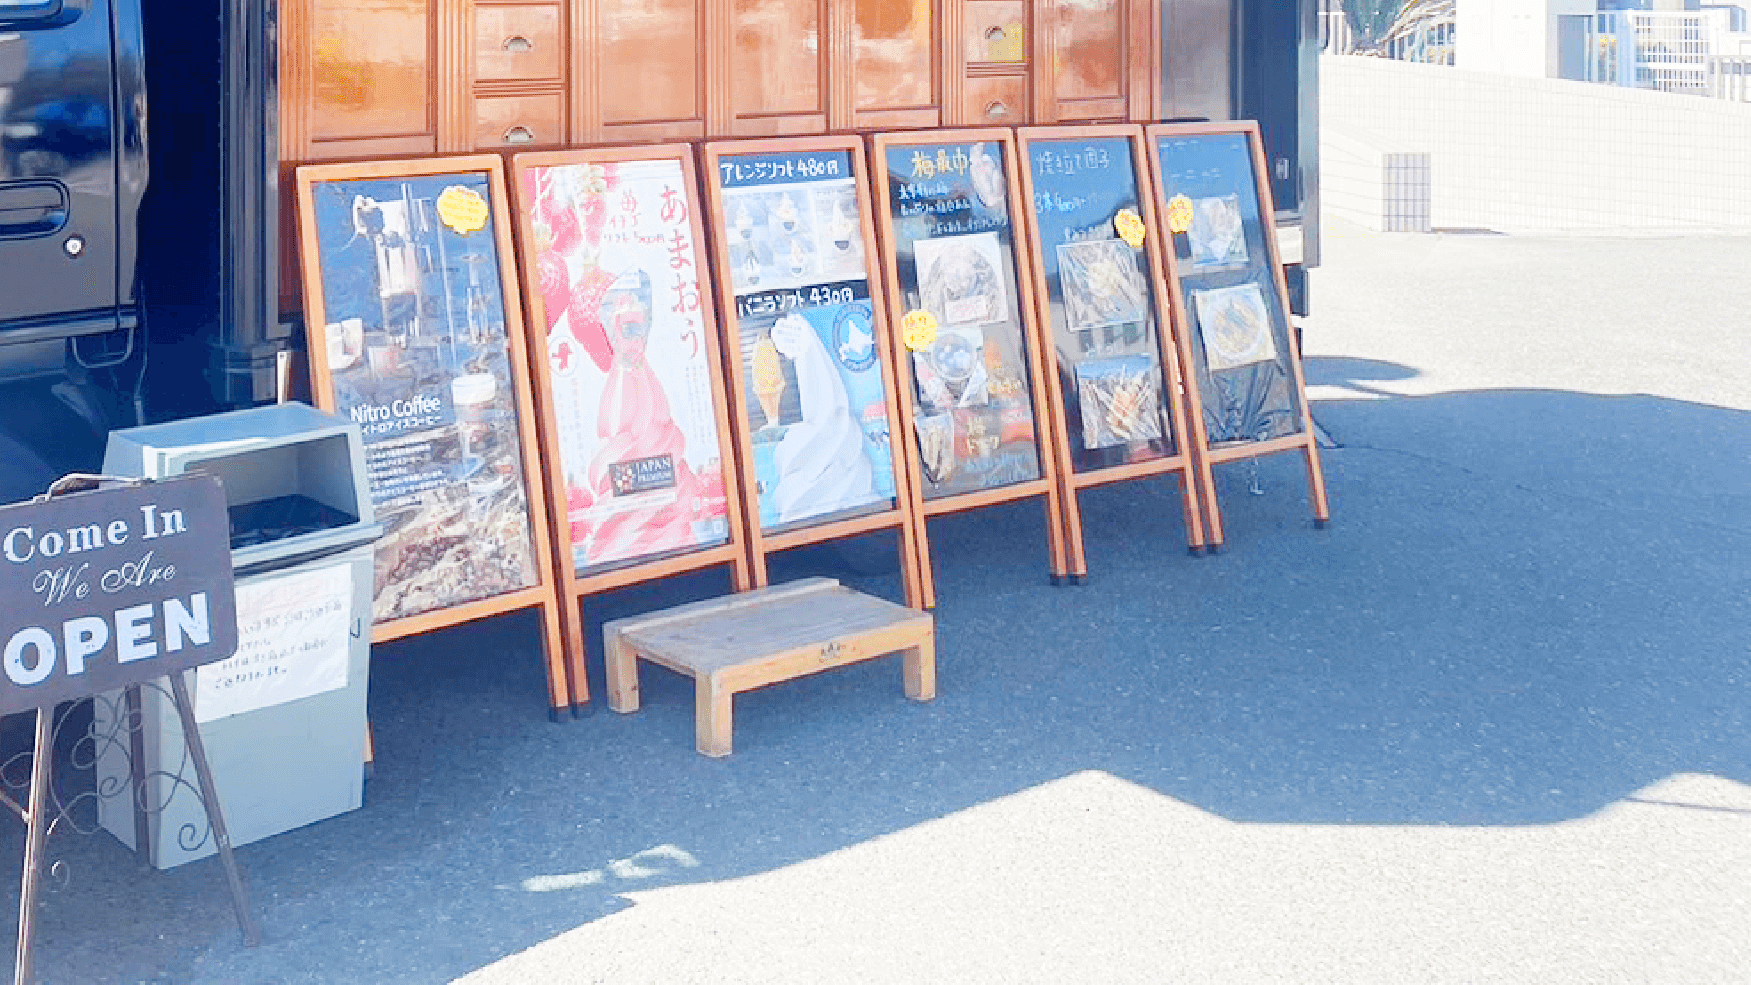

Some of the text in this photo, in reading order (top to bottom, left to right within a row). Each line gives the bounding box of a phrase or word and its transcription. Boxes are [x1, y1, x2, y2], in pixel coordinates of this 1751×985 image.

[660, 183, 700, 360] あまおう
[350, 394, 441, 424] Nitro Coffee
[3, 505, 187, 563] Come In
[33, 551, 177, 606] We Are
[3, 592, 211, 685] OPEN
